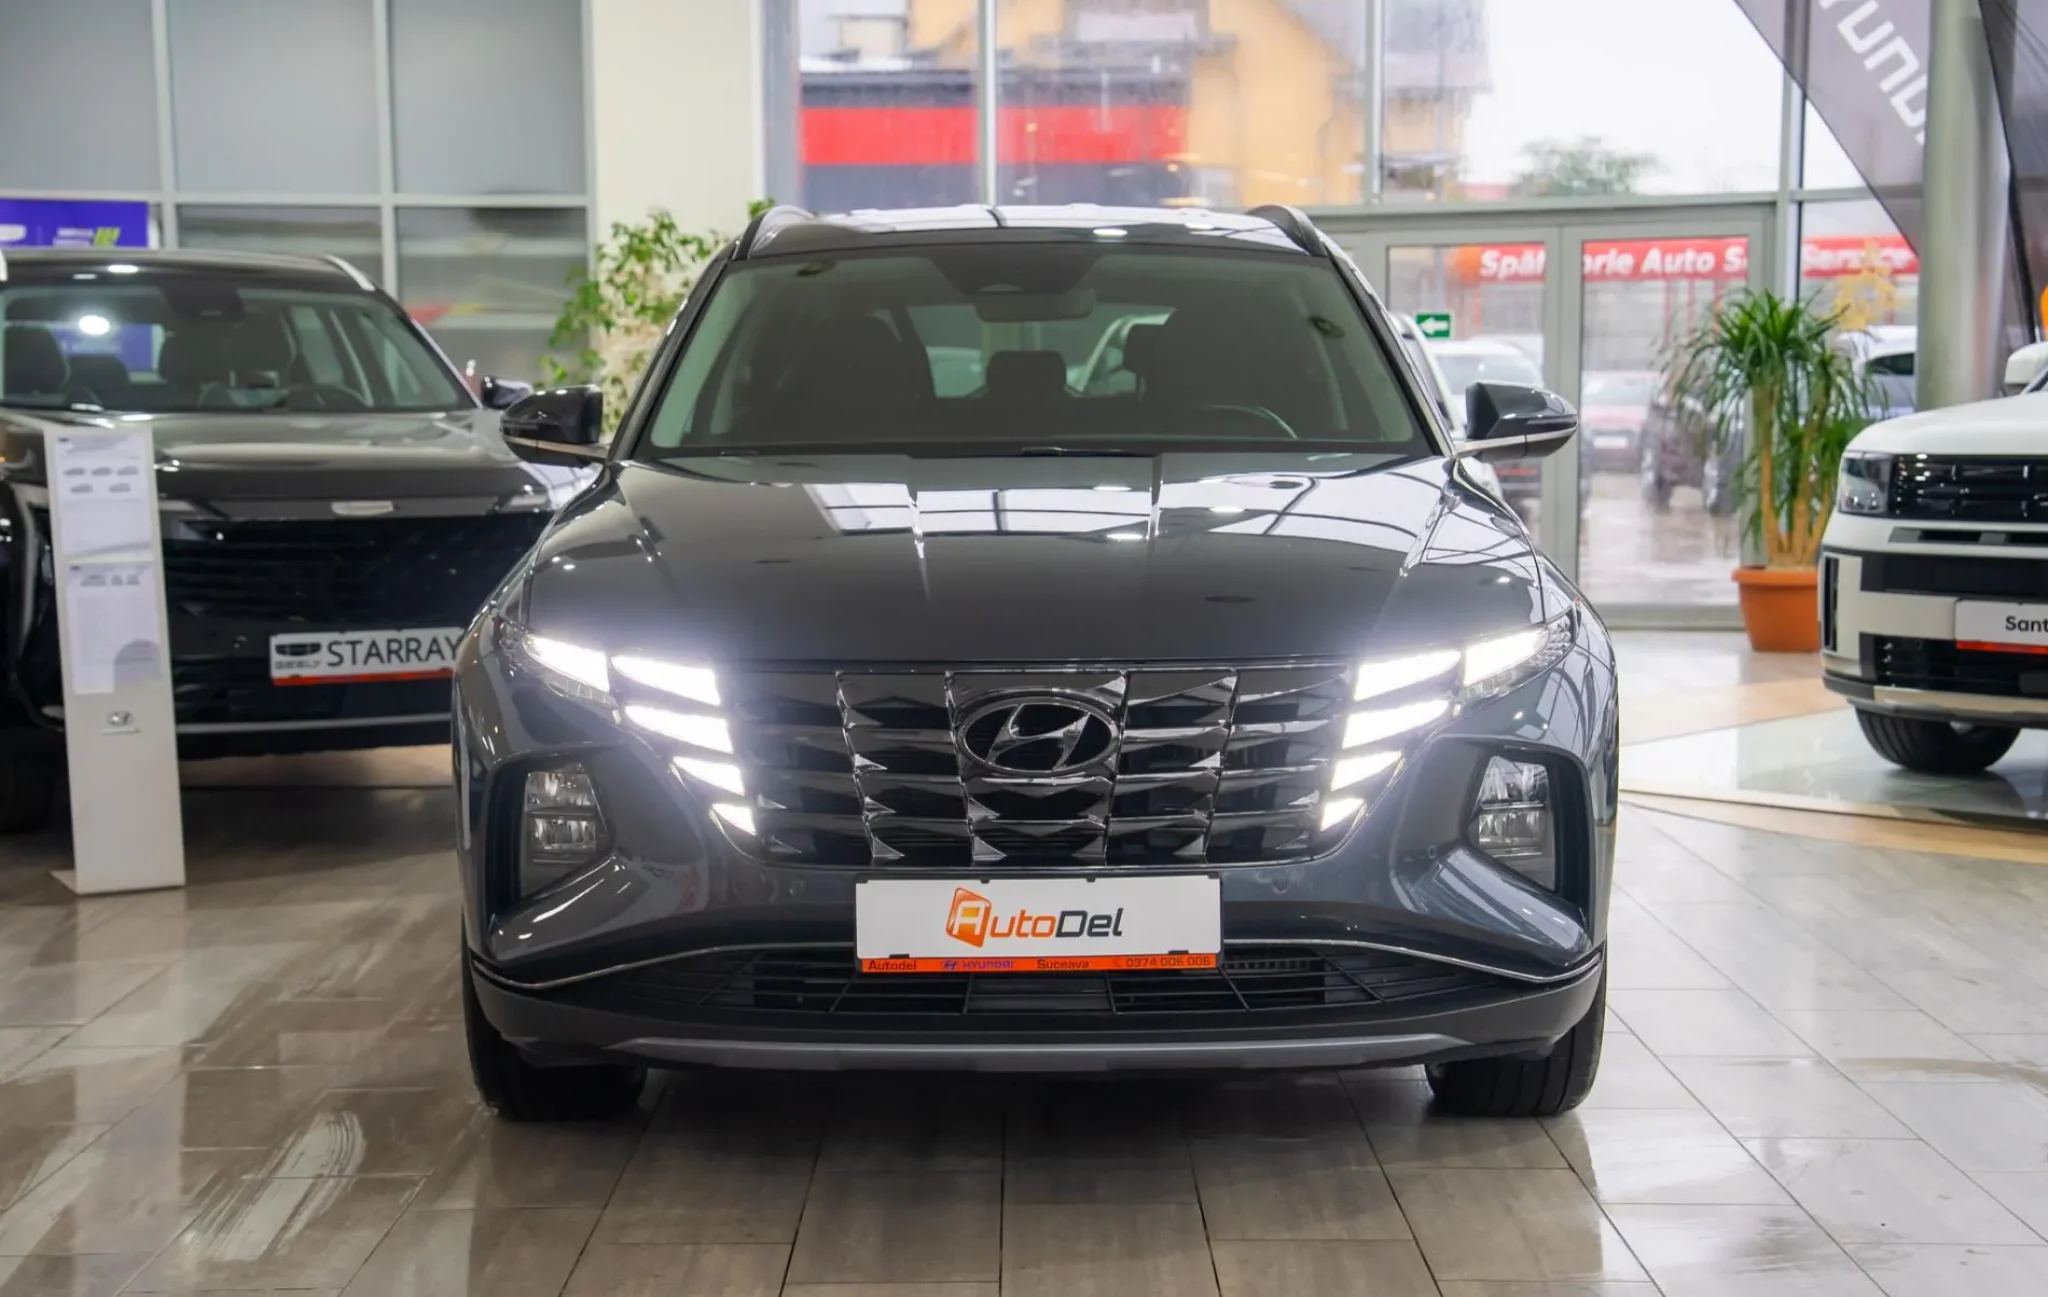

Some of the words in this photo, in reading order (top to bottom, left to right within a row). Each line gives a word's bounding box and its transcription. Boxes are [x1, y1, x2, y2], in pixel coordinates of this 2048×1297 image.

[1641, 247, 1715, 274] Auto
[327, 636, 464, 667] STARRAY
[952, 900, 1124, 938] AutoDel
[868, 960, 917, 971] Autodel
[1037, 958, 1089, 970] Suceava
[1126, 957, 1156, 968] 0374
[1160, 957, 1183, 967] 006
[1187, 956, 1211, 967] 006
